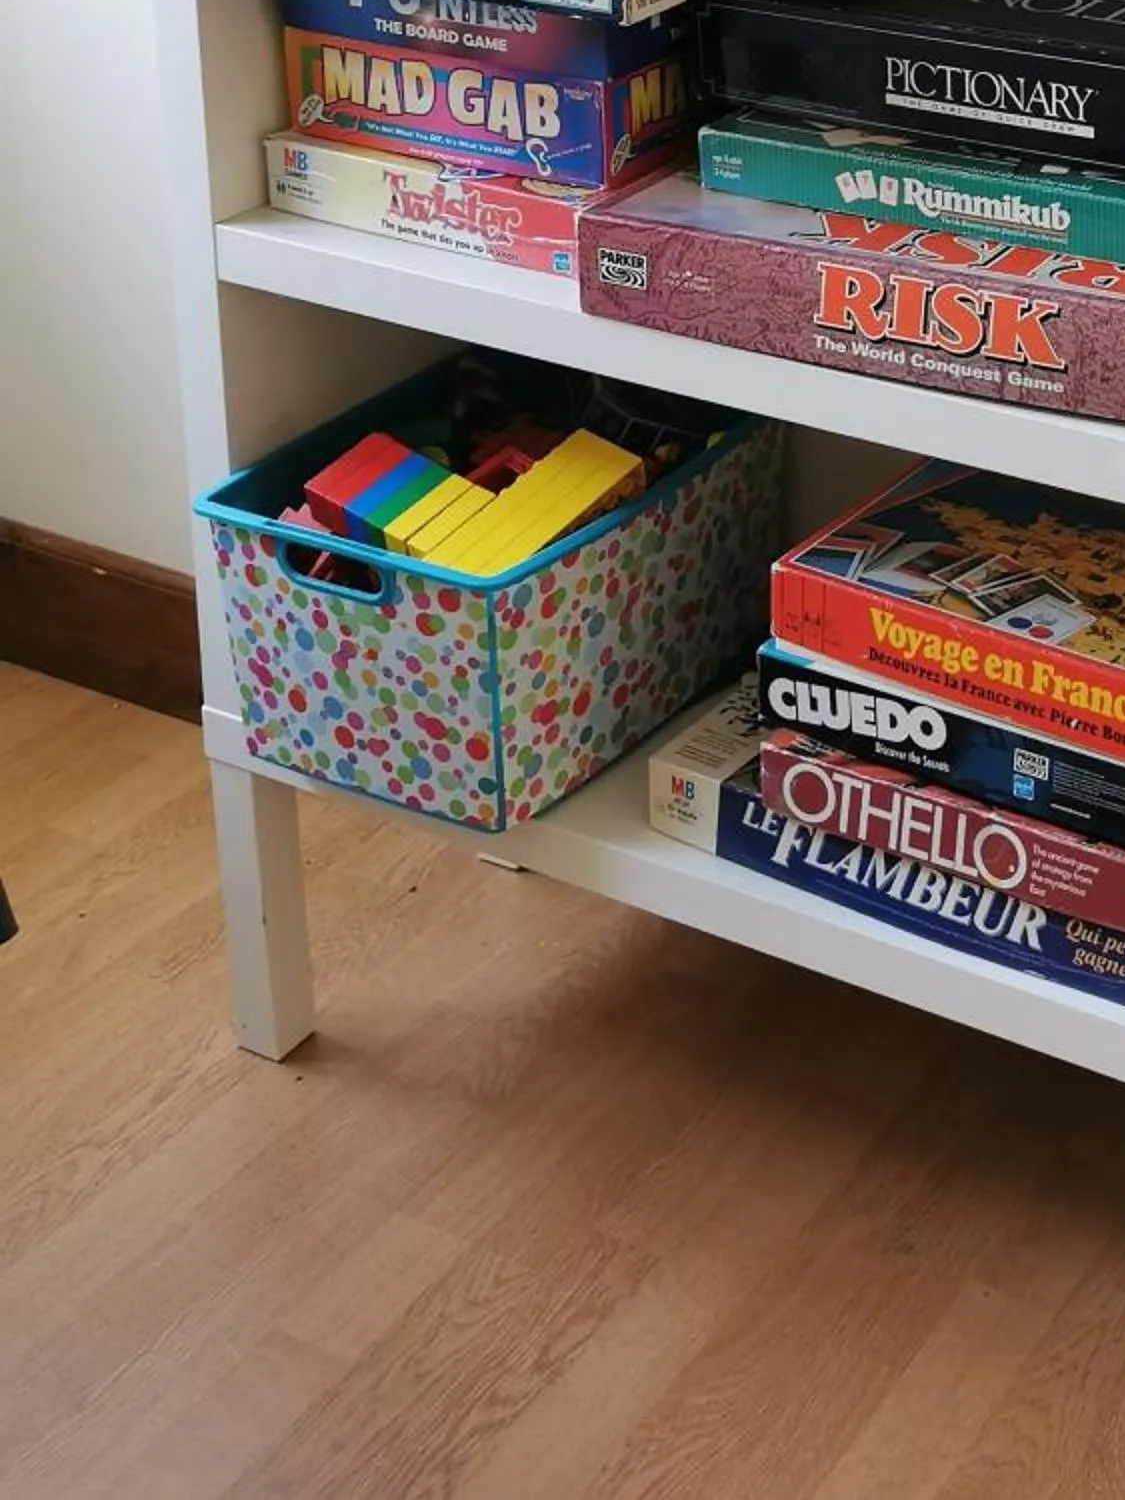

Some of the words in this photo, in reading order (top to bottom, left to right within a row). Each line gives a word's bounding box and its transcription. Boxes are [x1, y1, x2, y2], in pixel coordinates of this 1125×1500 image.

[373, 17, 404, 35] THE
[405, 23, 460, 45] BOARD
[462, 32, 509, 53] GAME
[319, 45, 436, 117] MAD
[447, 68, 562, 143] GAB
[630, 62, 689, 137] MA
[884, 57, 1095, 123] PICTIONARY
[283, 147, 309, 171] MB
[381, 218, 396, 233] The
[397, 224, 420, 239] game
[422, 228, 438, 242] that
[455, 238, 472, 253] you
[472, 242, 485, 255] up
[383, 169, 524, 246] Twister
[903, 177, 1072, 232] Rummikub
[600, 248, 645, 269] PARKER
[814, 260, 1068, 372] RISK
[813, 333, 848, 355] The
[850, 339, 906, 366] World
[910, 350, 1003, 385] Conquest
[1007, 369, 1065, 395] Game
[867, 606, 981, 675] Voyage
[983, 653, 1024, 687] en
[766, 676, 949, 752] CLUEDO
[867, 646, 943, 687] Découvrez
[942, 669, 960, 692] la
[960, 676, 1013, 710] France
[1012, 696, 1048, 723] avec
[1049, 703, 1100, 740] Pierre
[874, 740, 908, 763] Discover
[908, 750, 922, 765] the
[671, 775, 695, 800] MB
[741, 800, 779, 838] LE
[782, 762, 1029, 891] OTHELLO
[771, 822, 1048, 953] FLAMBEUR
[1063, 917, 1102, 943] Qui
